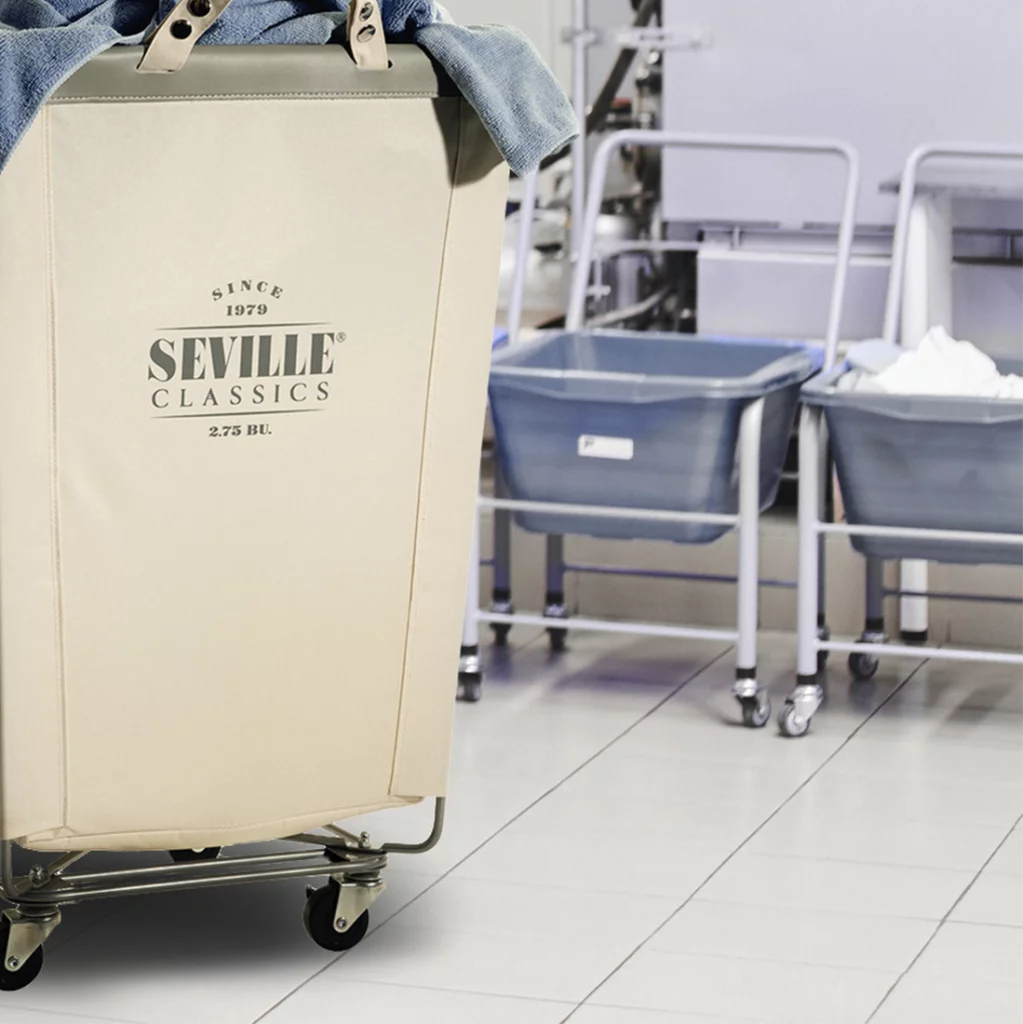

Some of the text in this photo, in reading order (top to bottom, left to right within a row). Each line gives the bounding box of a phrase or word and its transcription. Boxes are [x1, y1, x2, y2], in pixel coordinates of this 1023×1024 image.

[211, 279, 284, 302] SINCE
[226, 303, 268, 317] 1979
[151, 380, 330, 409] CLASSICS
[208, 423, 272, 438] 2.75 BU.
